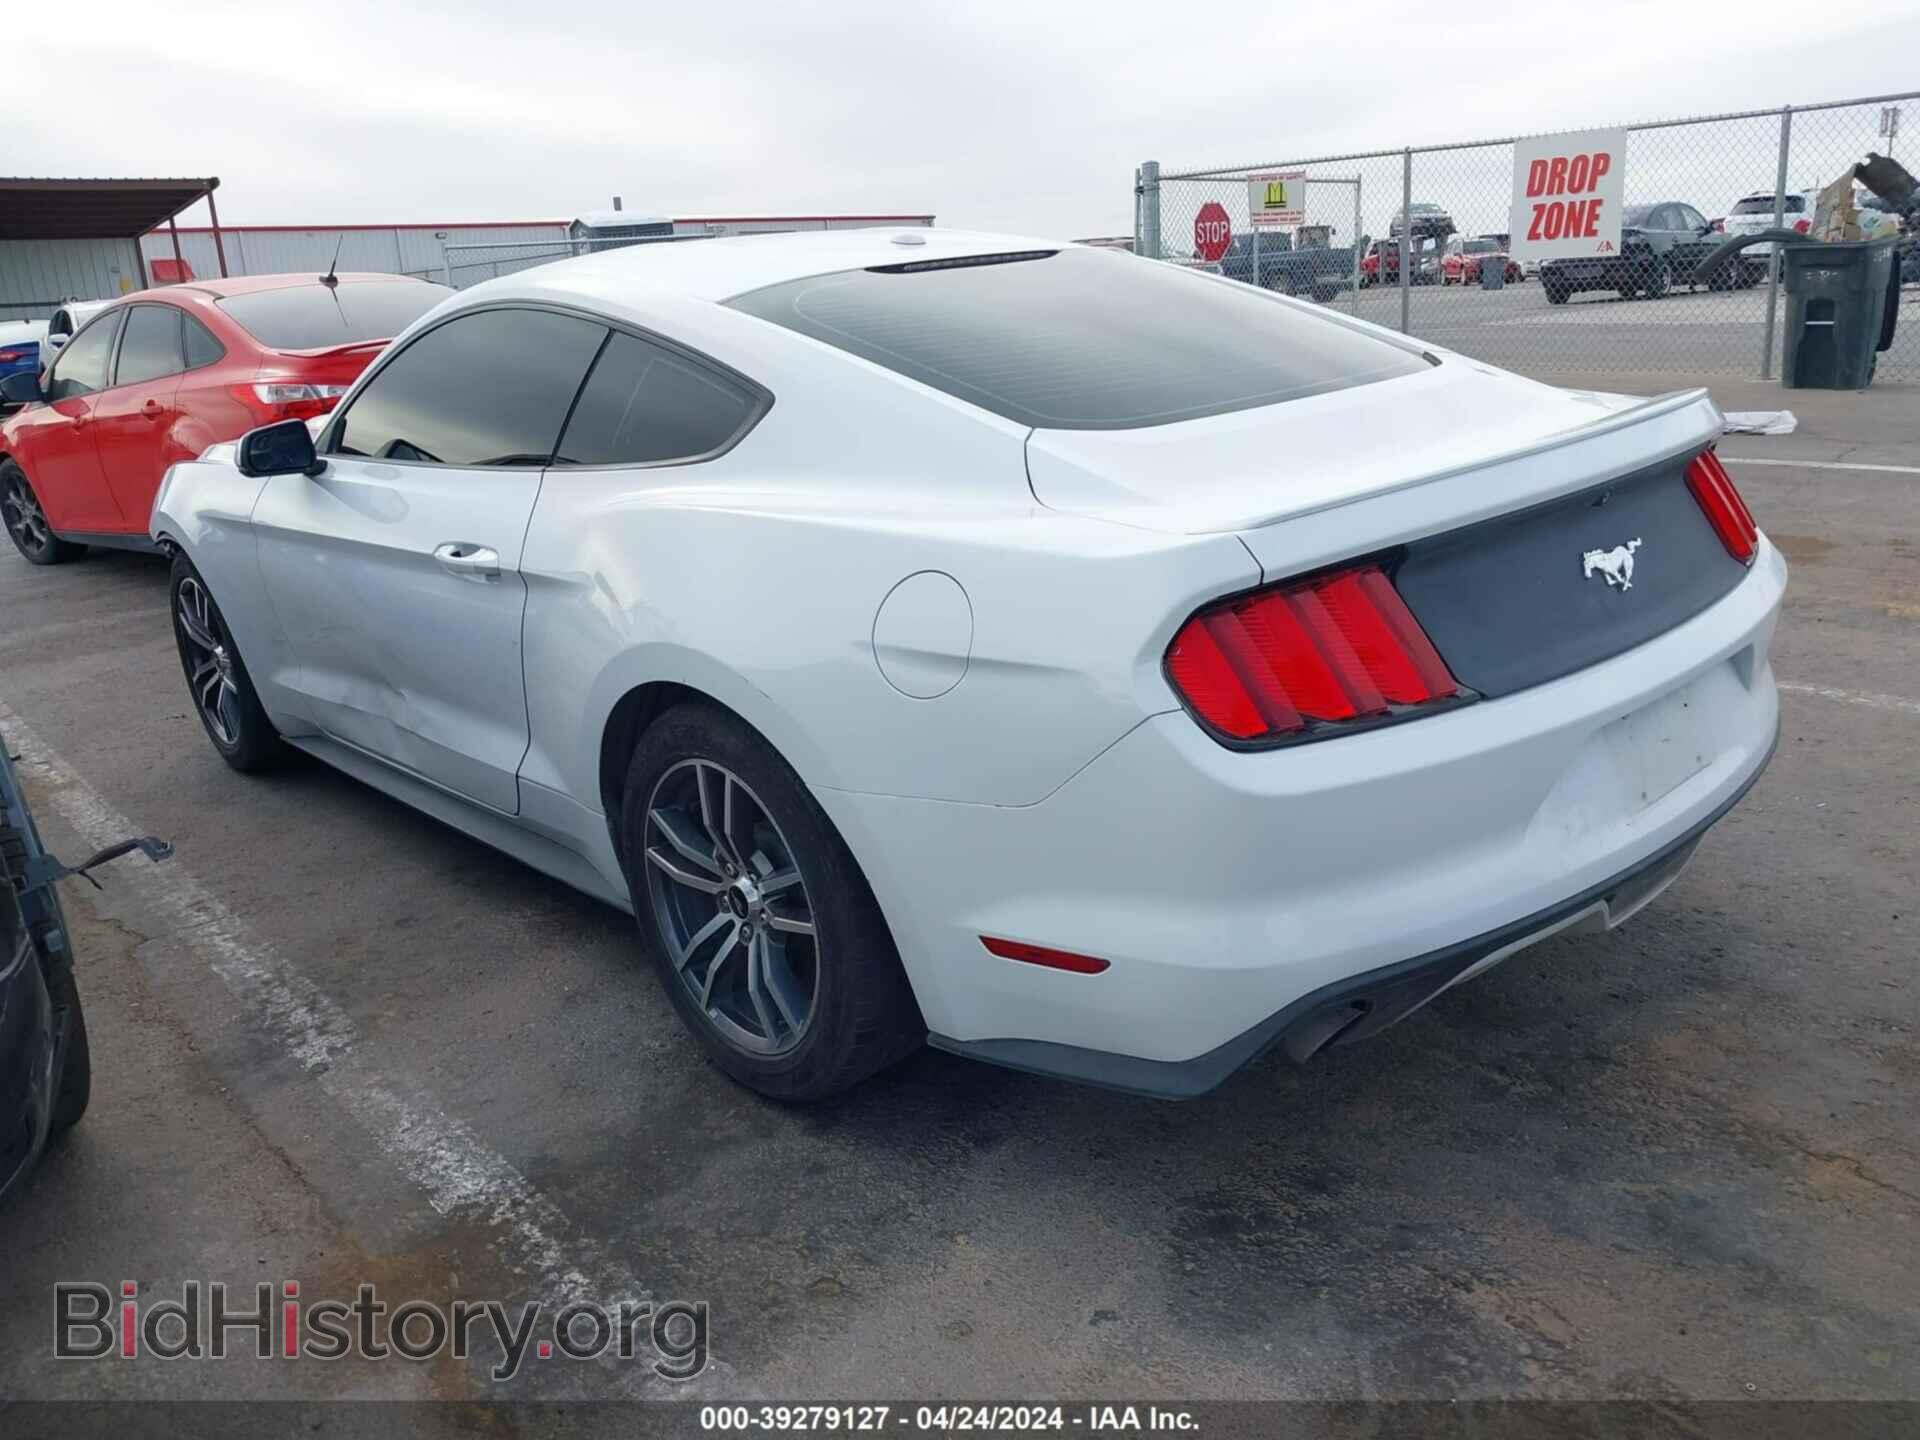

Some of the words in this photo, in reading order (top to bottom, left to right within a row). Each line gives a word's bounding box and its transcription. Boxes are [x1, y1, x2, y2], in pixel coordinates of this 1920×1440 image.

[1526, 153, 1610, 197] DROP
[1197, 221, 1229, 244] STOP
[1527, 199, 1603, 240] ZONE
